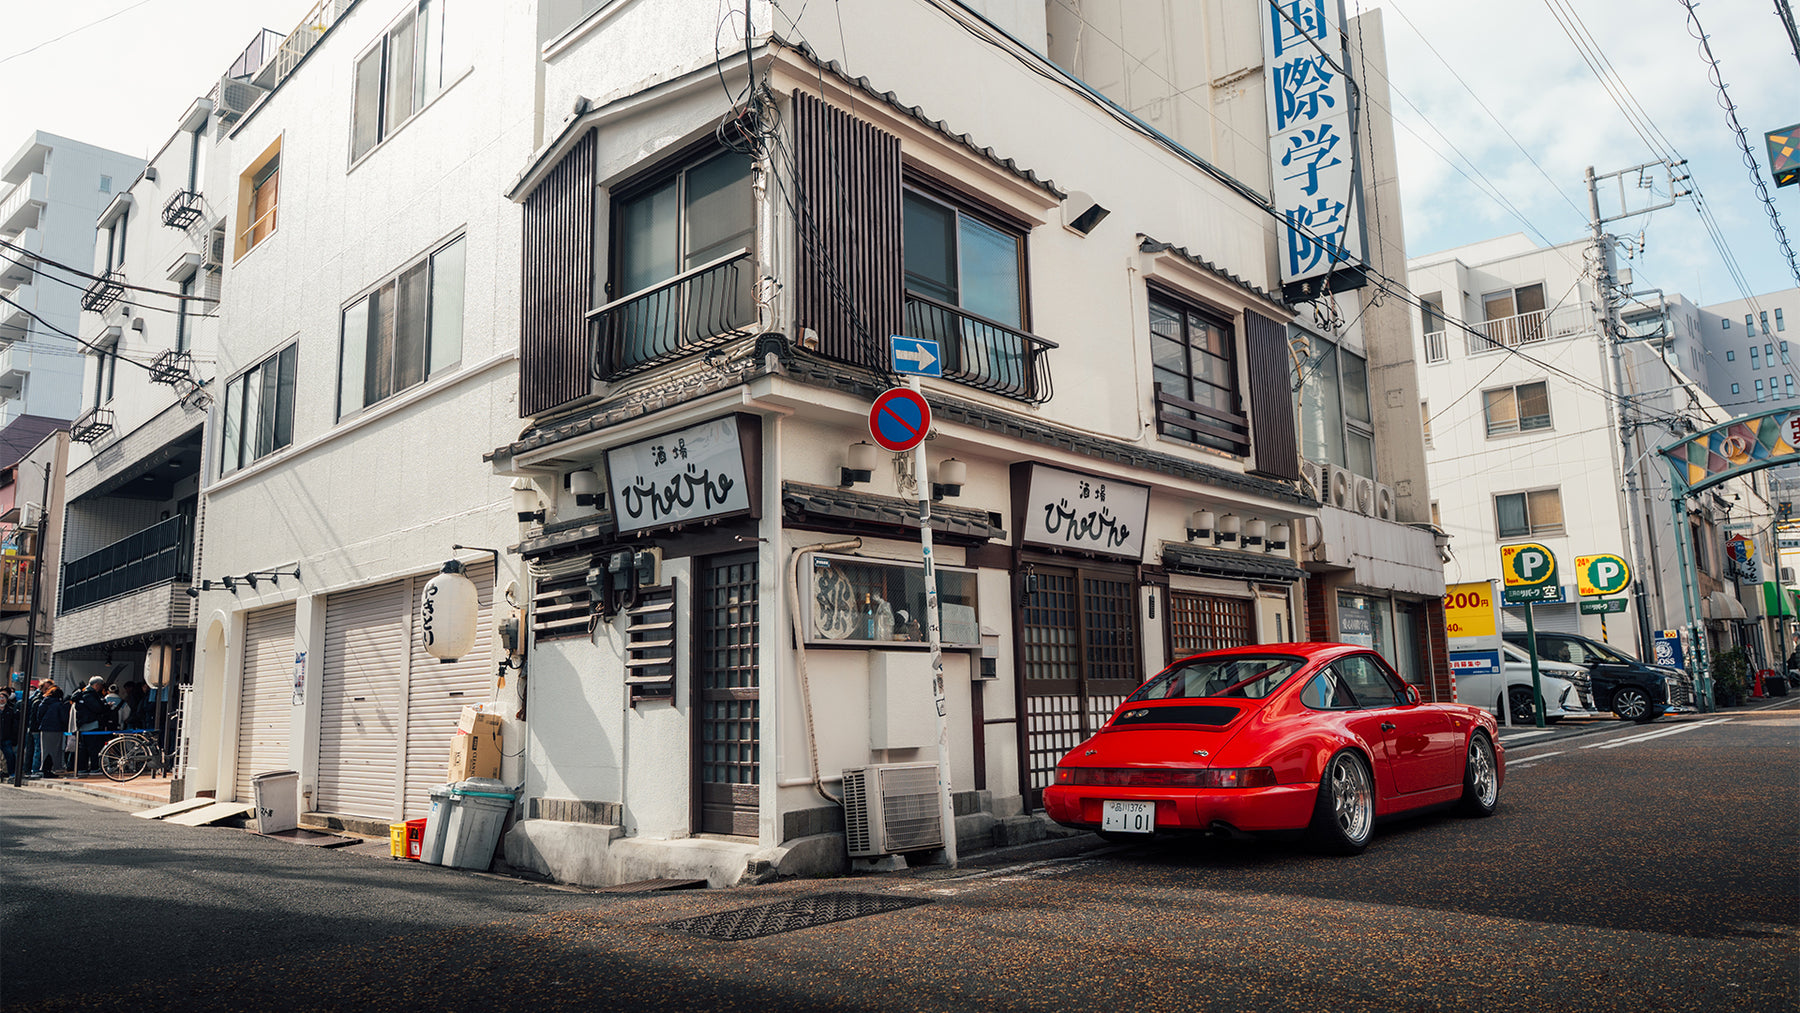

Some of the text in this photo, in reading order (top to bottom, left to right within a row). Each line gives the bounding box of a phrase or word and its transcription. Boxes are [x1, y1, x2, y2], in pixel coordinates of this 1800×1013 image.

[1270, 0, 1351, 277] 国際学院
[651, 438, 688, 467] 酒場
[1080, 481, 1106, 502] 酒場
[1522, 552, 1544, 578] P
[1597, 562, 1619, 588] P
[1542, 586, 1558, 598] 空
[422, 583, 439, 646] やきとり
